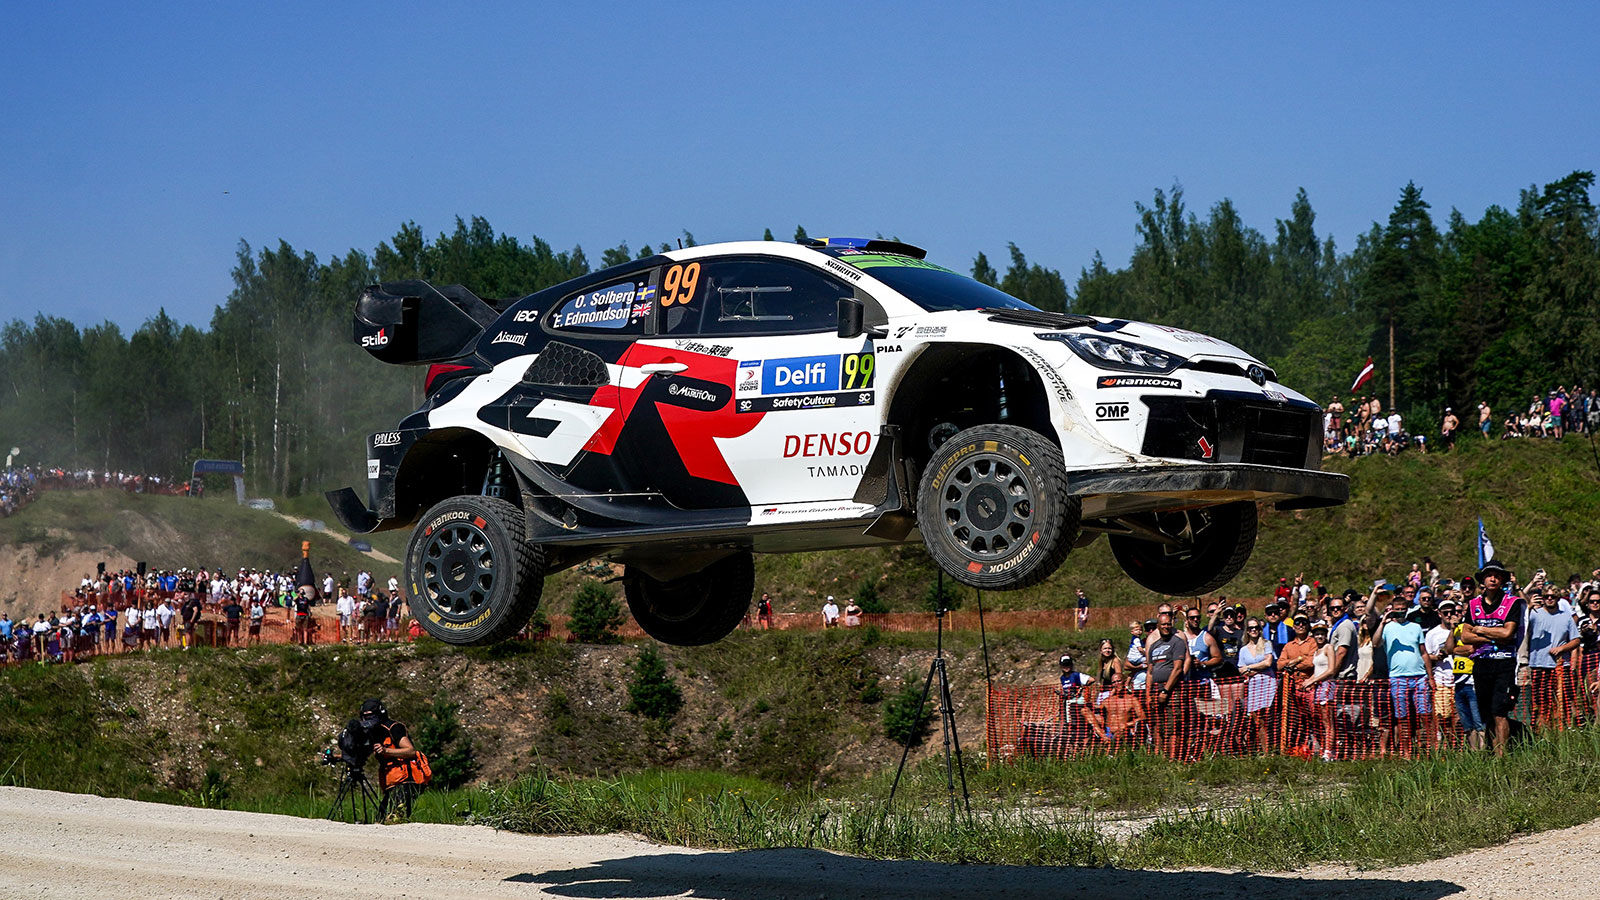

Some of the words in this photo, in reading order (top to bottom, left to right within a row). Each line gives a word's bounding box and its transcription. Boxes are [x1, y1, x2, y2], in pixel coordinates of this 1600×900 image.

[660, 262, 701, 307] 99
[575, 294, 587, 309] O.
[590, 290, 636, 306] Solberg
[552, 313, 563, 328] E.
[564, 306, 631, 327] Edmondson
[361, 331, 389, 347] stilo
[877, 344, 903, 353] PIAA
[775, 362, 827, 387] Delfi
[845, 354, 875, 389] 99
[740, 400, 752, 410] SC
[773, 395, 836, 408] SafetyCulture
[858, 393, 871, 402] SC
[1096, 405, 1130, 417] OMP
[783, 431, 872, 458] DENSO
[1454, 660, 1466, 671] 18
